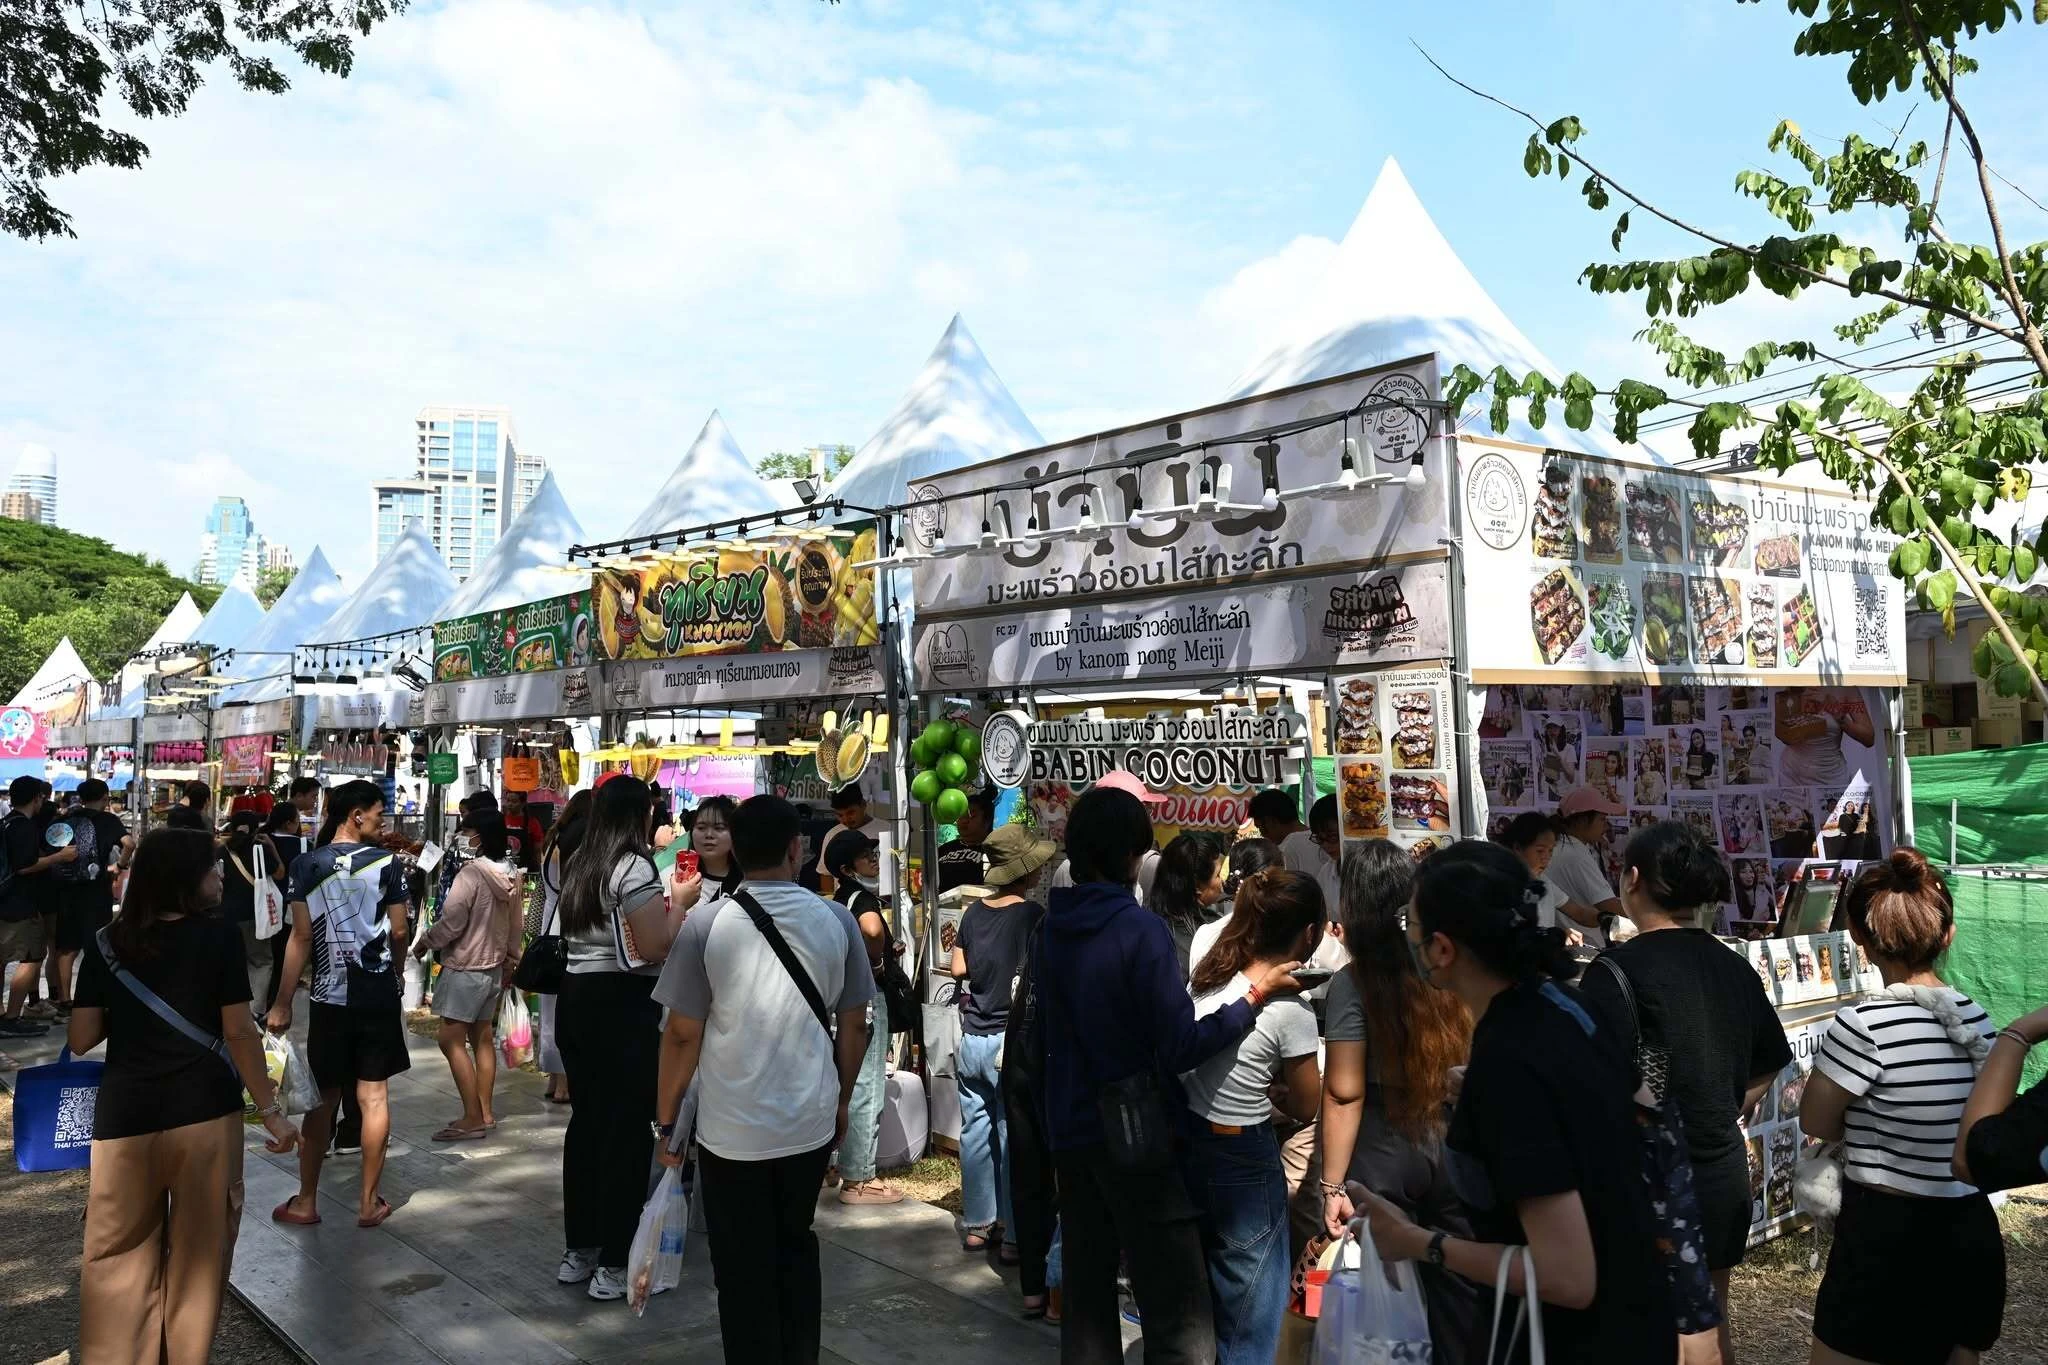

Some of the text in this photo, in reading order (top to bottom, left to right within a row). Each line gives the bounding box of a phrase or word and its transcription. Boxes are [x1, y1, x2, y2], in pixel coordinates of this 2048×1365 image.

[1808, 532, 1843, 549] KANOM
[1846, 536, 1873, 553] NONG
[987, 536, 1304, 605] มะพร้าวอ่อนไส้ทะลัก
[662, 549, 768, 653] ทุเรียน
[996, 625, 1018, 637] FC 27
[1030, 604, 1251, 648] ขนมบ้าบิ่นมะพร้าวอ่อนไส้ทะลัก
[665, 664, 711, 688] หมวยเล็ก
[716, 661, 801, 690] ทุเรียนหมอนทอง
[1055, 637, 1225, 679] by kanom nong Meiji
[1027, 708, 1291, 743] ขนมบ้าบิ่น มะพร้าวอ่อนไส้ทะลัก
[1030, 748, 1289, 786] BABIN COCONUT
